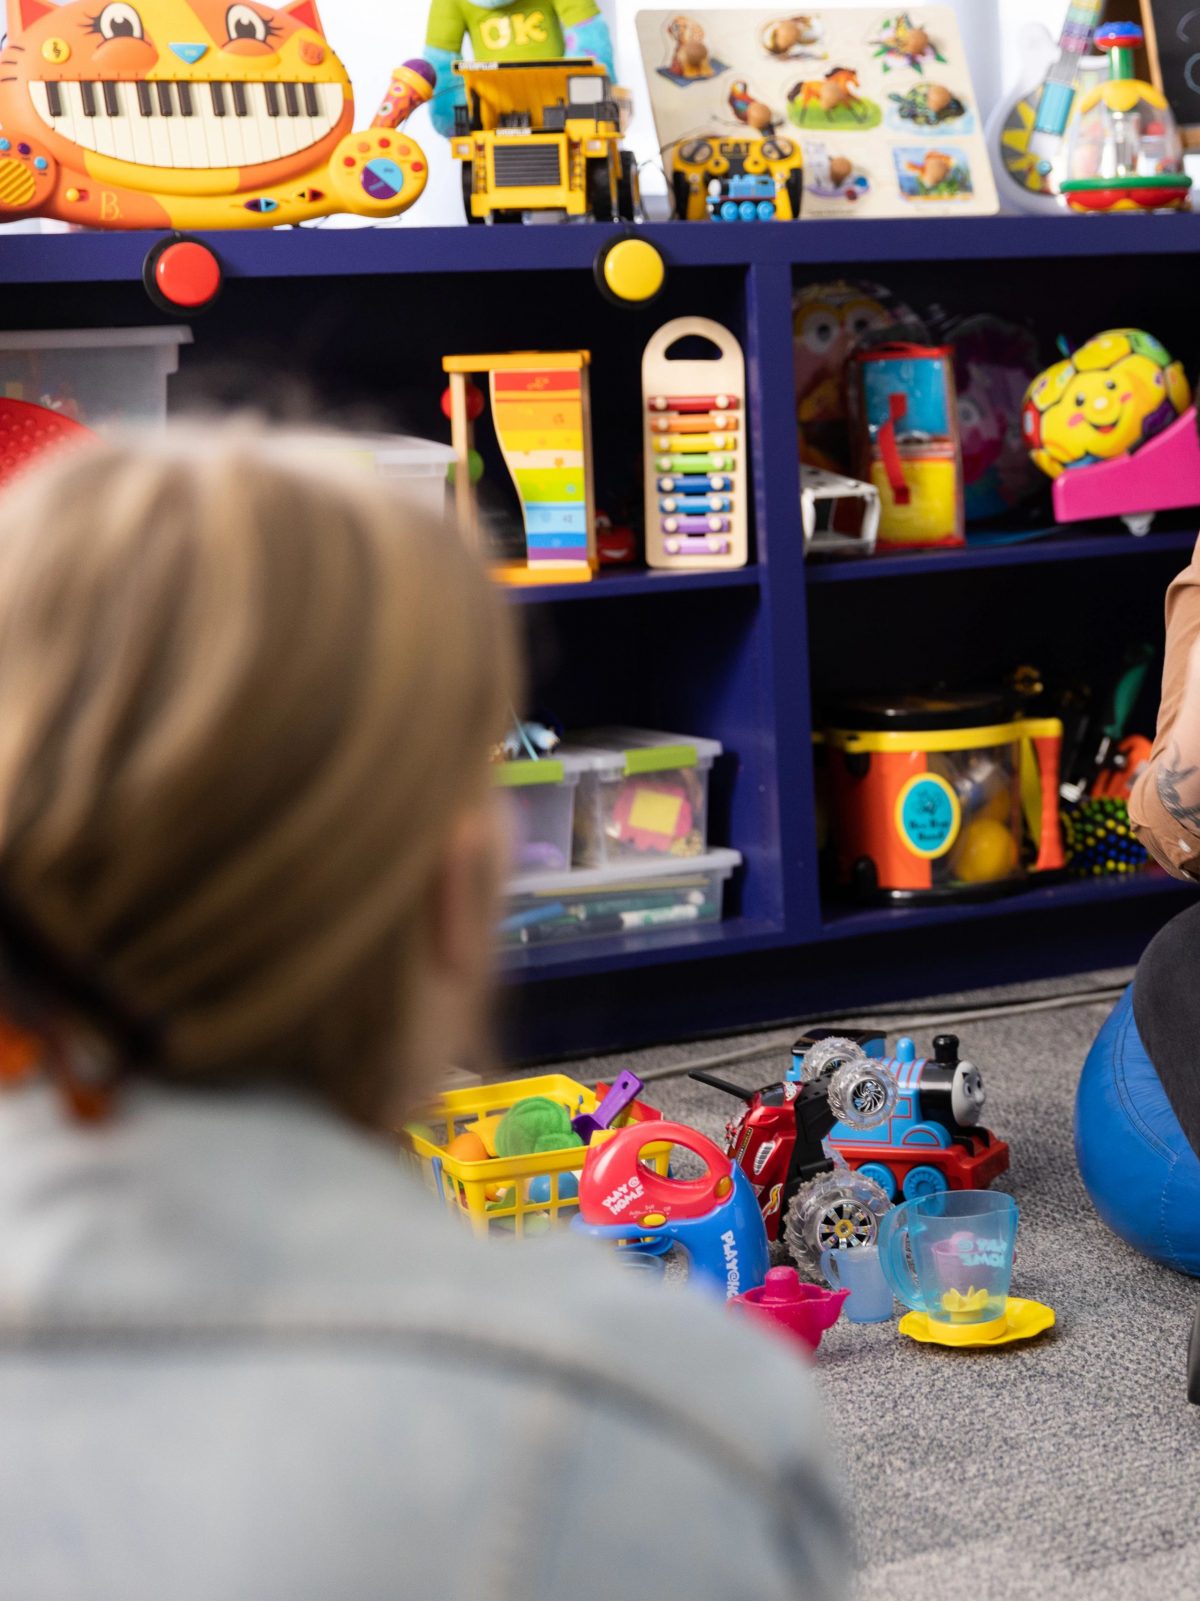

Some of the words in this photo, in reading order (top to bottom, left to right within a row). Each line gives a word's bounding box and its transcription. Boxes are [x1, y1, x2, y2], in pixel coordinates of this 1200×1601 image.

[480, 11, 548, 50] OK
[602, 1184, 629, 1208] PLAY
[610, 1184, 645, 1215] HOME
